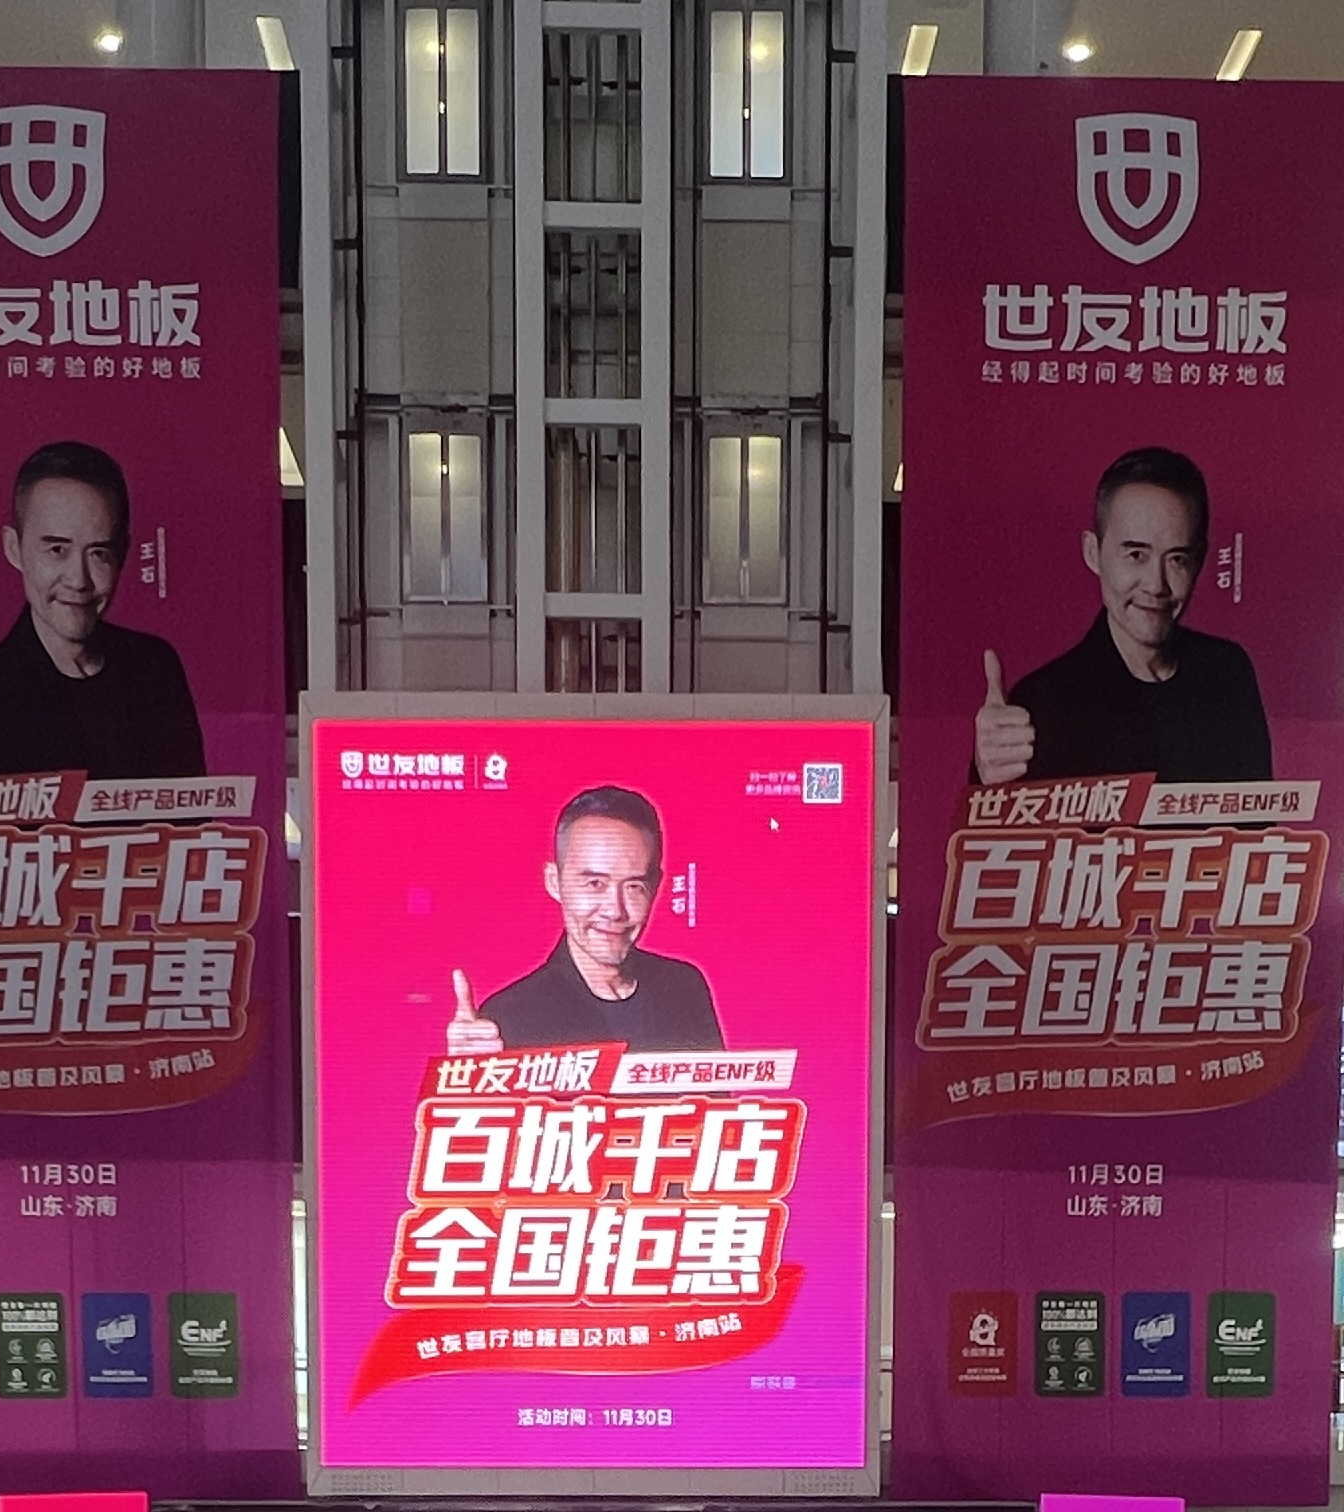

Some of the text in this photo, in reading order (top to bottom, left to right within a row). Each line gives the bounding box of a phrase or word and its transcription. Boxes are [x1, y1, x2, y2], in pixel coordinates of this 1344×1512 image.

[982, 284, 1288, 354] 世友地板
[981, 360, 1286, 386] 经得起时间考验的好地板
[367, 753, 466, 777] 世友地板
[90, 787, 238, 811] 全线产品ENF级
[968, 778, 1301, 826] 世友地板 全线产品ENF级
[952, 836, 1311, 930] 百城千店
[930, 940, 1293, 1038] 全国钜惠
[436, 1050, 777, 1095] 世友地板 全线产品ENF级
[421, 1103, 788, 1194] 百城千店
[20, 1163, 117, 1186] 11月30日
[1068, 1163, 1164, 1186] 11月30日
[20, 1195, 118, 1218] 山东·济南
[1066, 1194, 1163, 1218] 山东·济南
[399, 1205, 771, 1297] 全国钜惠
